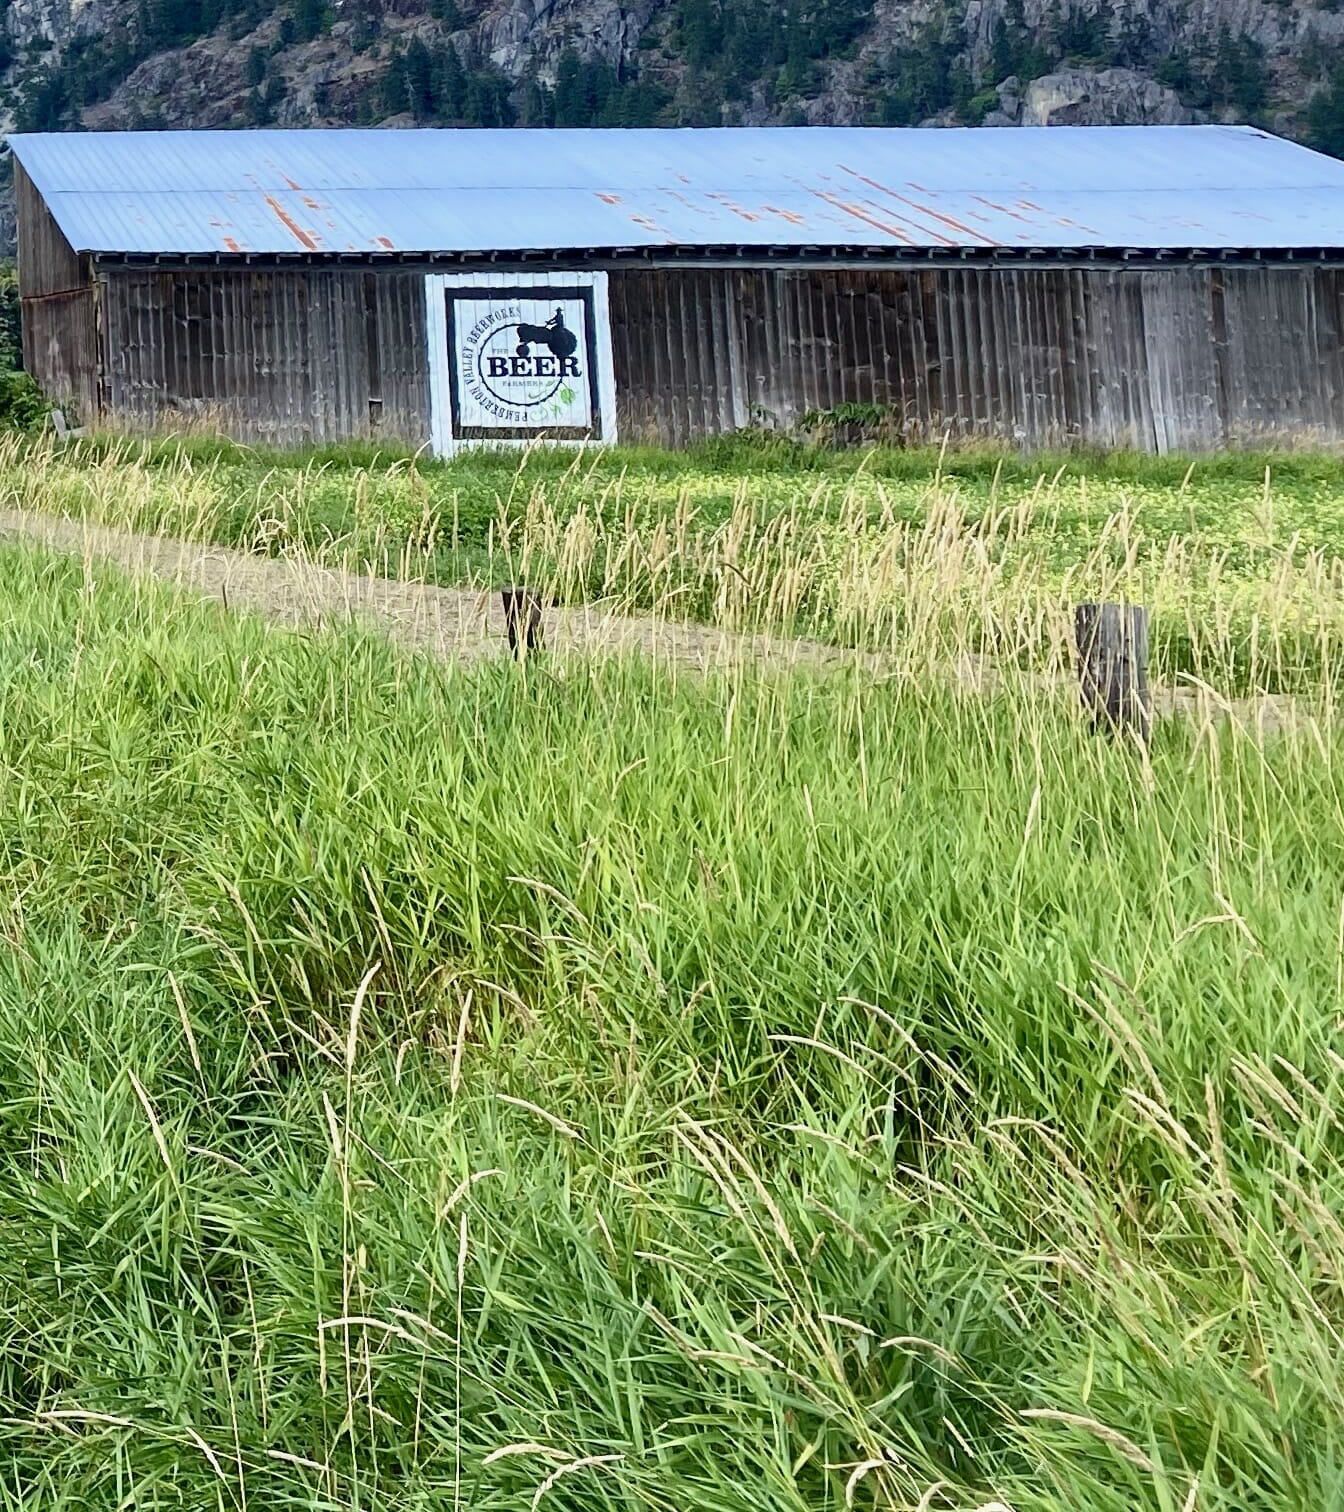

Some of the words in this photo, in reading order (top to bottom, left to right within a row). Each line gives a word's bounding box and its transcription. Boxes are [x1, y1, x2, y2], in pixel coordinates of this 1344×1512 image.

[467, 306, 521, 344] BEERWORKS
[463, 346, 474, 385] VALLEY
[487, 356, 582, 378] BEER
[470, 386, 528, 422] PEMBERTON
